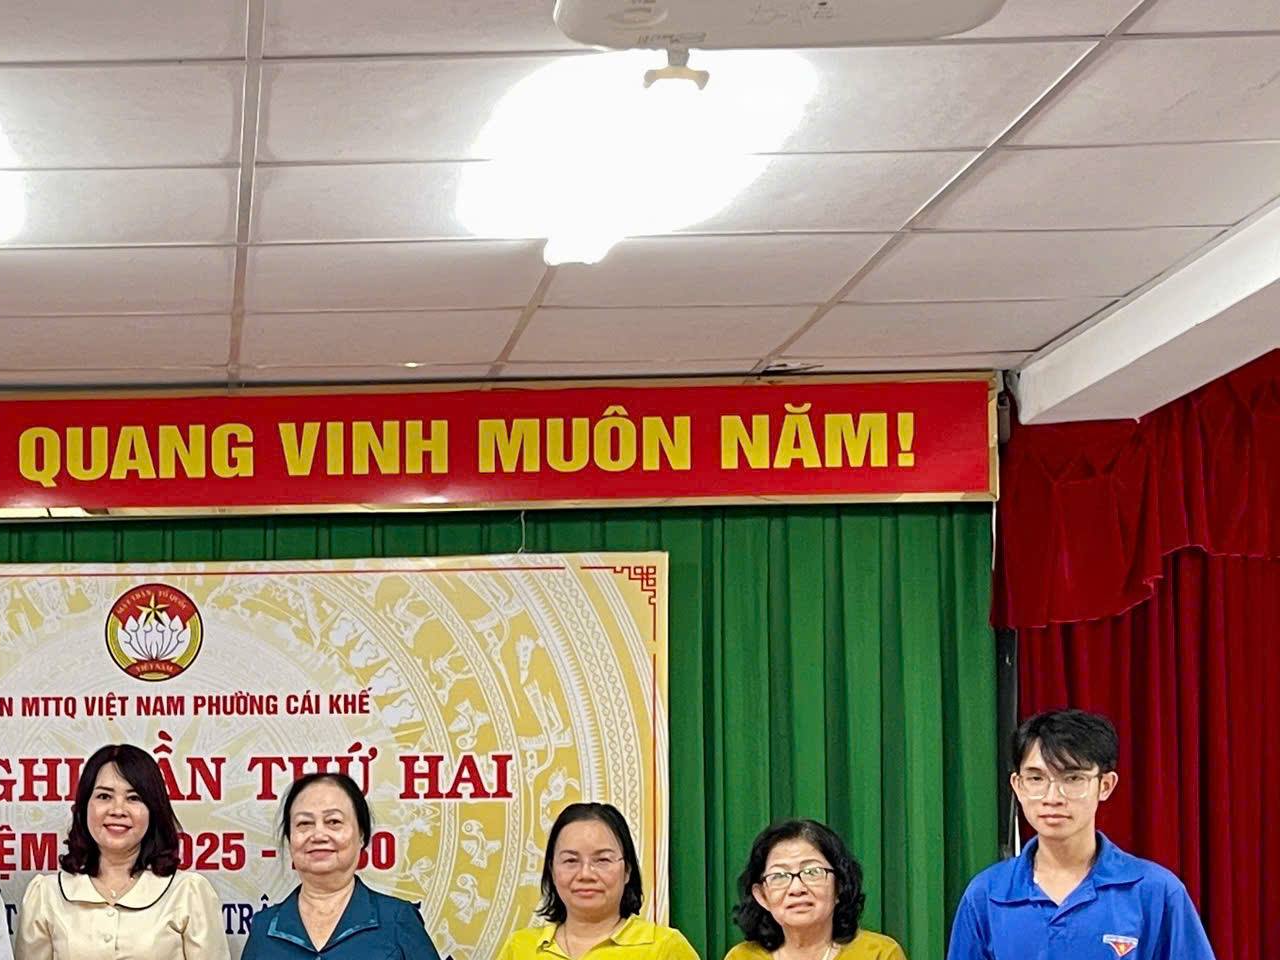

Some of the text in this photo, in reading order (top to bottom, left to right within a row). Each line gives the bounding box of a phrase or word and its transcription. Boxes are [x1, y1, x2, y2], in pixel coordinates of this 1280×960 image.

[19, 423, 254, 488] QUANG
[279, 420, 448, 476] VINH
[478, 405, 692, 473] MUÔN
[721, 402, 915, 469] NĂM!
[21, 696, 77, 719] MTTQ
[84, 692, 129, 721] VIỆT
[136, 696, 185, 716] NAM
[193, 690, 279, 716] PHƯỜNG
[285, 689, 321, 715] CÁI
[329, 687, 373, 714] KHẾ
[153, 730, 227, 801] ẦN
[398, 754, 513, 800] HAI
[176, 831, 246, 871] 025
